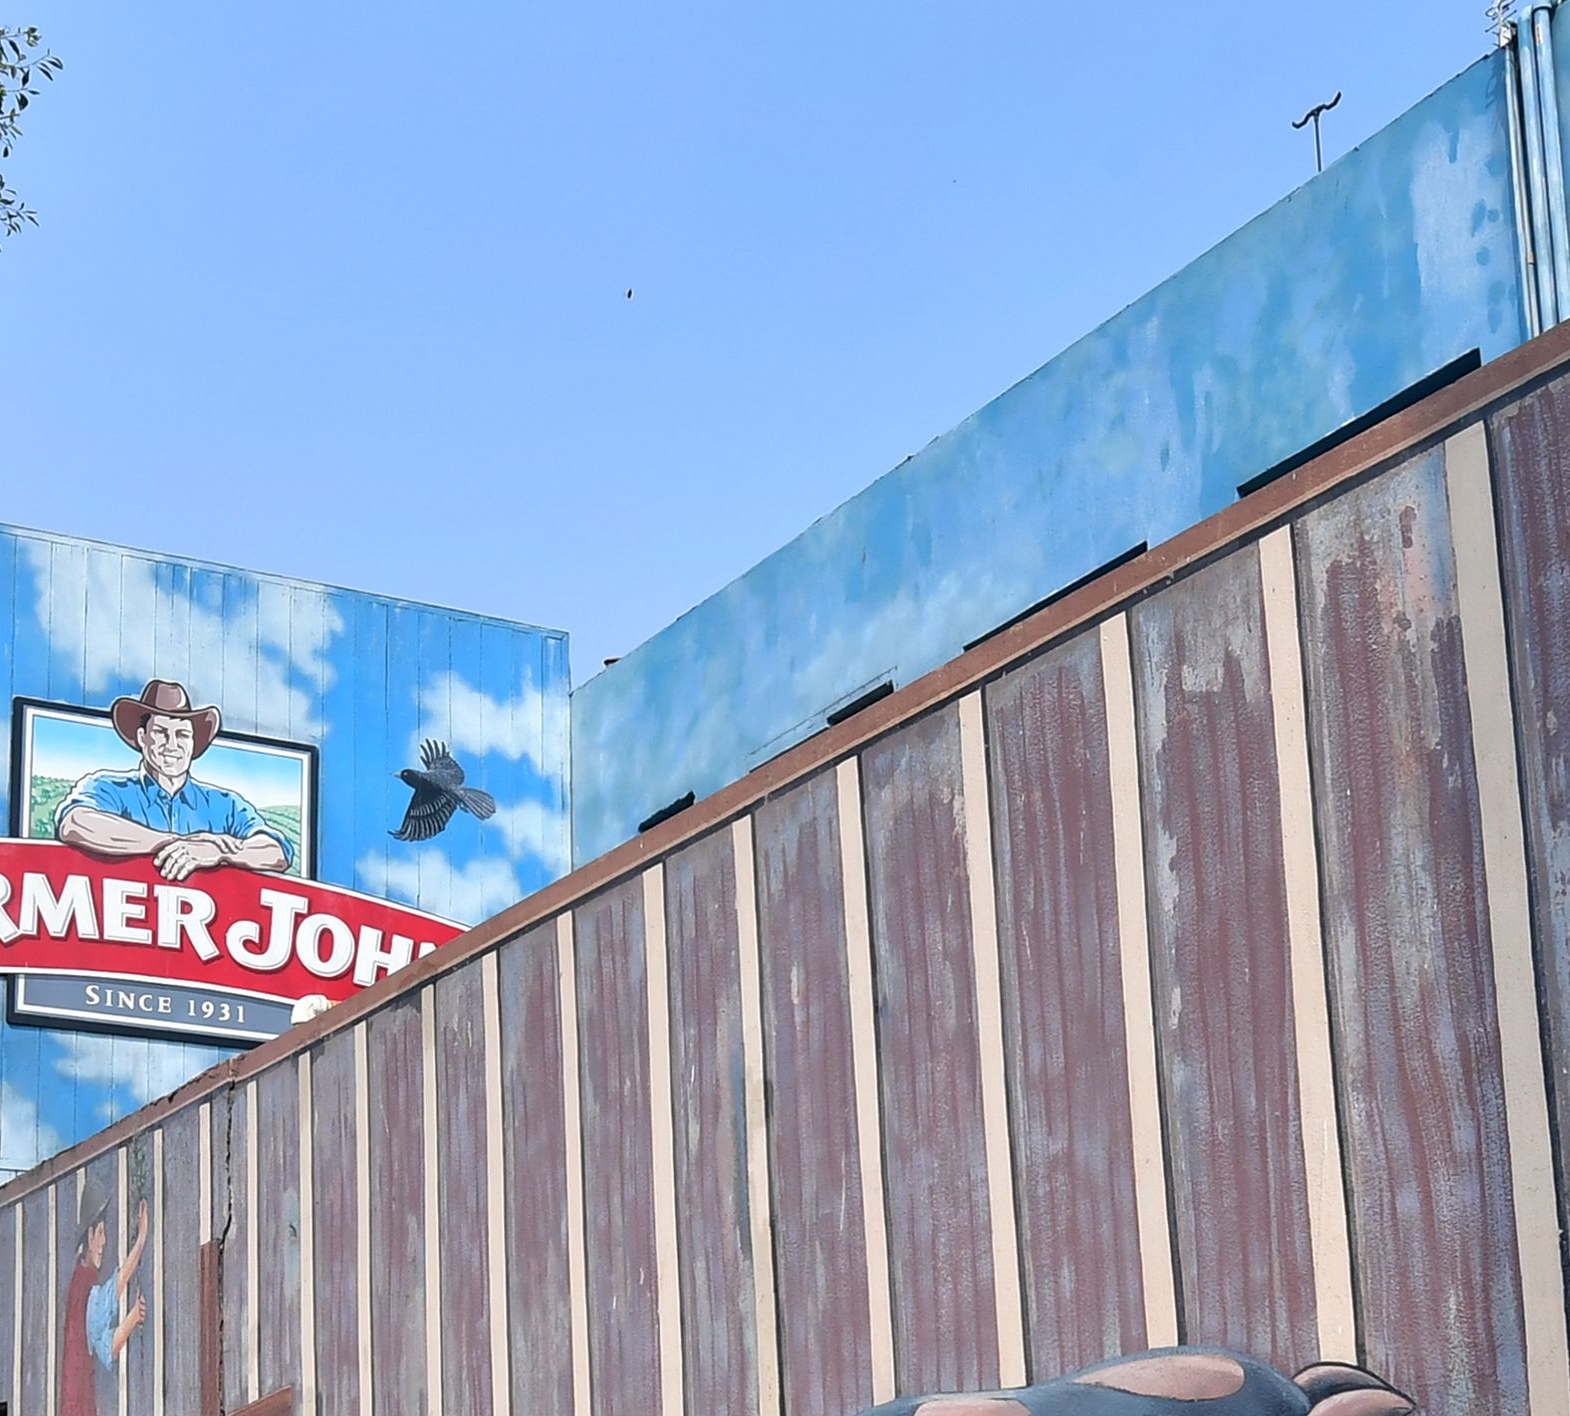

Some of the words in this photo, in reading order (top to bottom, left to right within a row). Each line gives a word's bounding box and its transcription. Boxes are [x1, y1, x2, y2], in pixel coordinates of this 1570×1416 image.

[226, 888, 438, 986] JOH
[85, 984, 172, 1014] SINCE
[187, 999, 246, 1023] 1931
